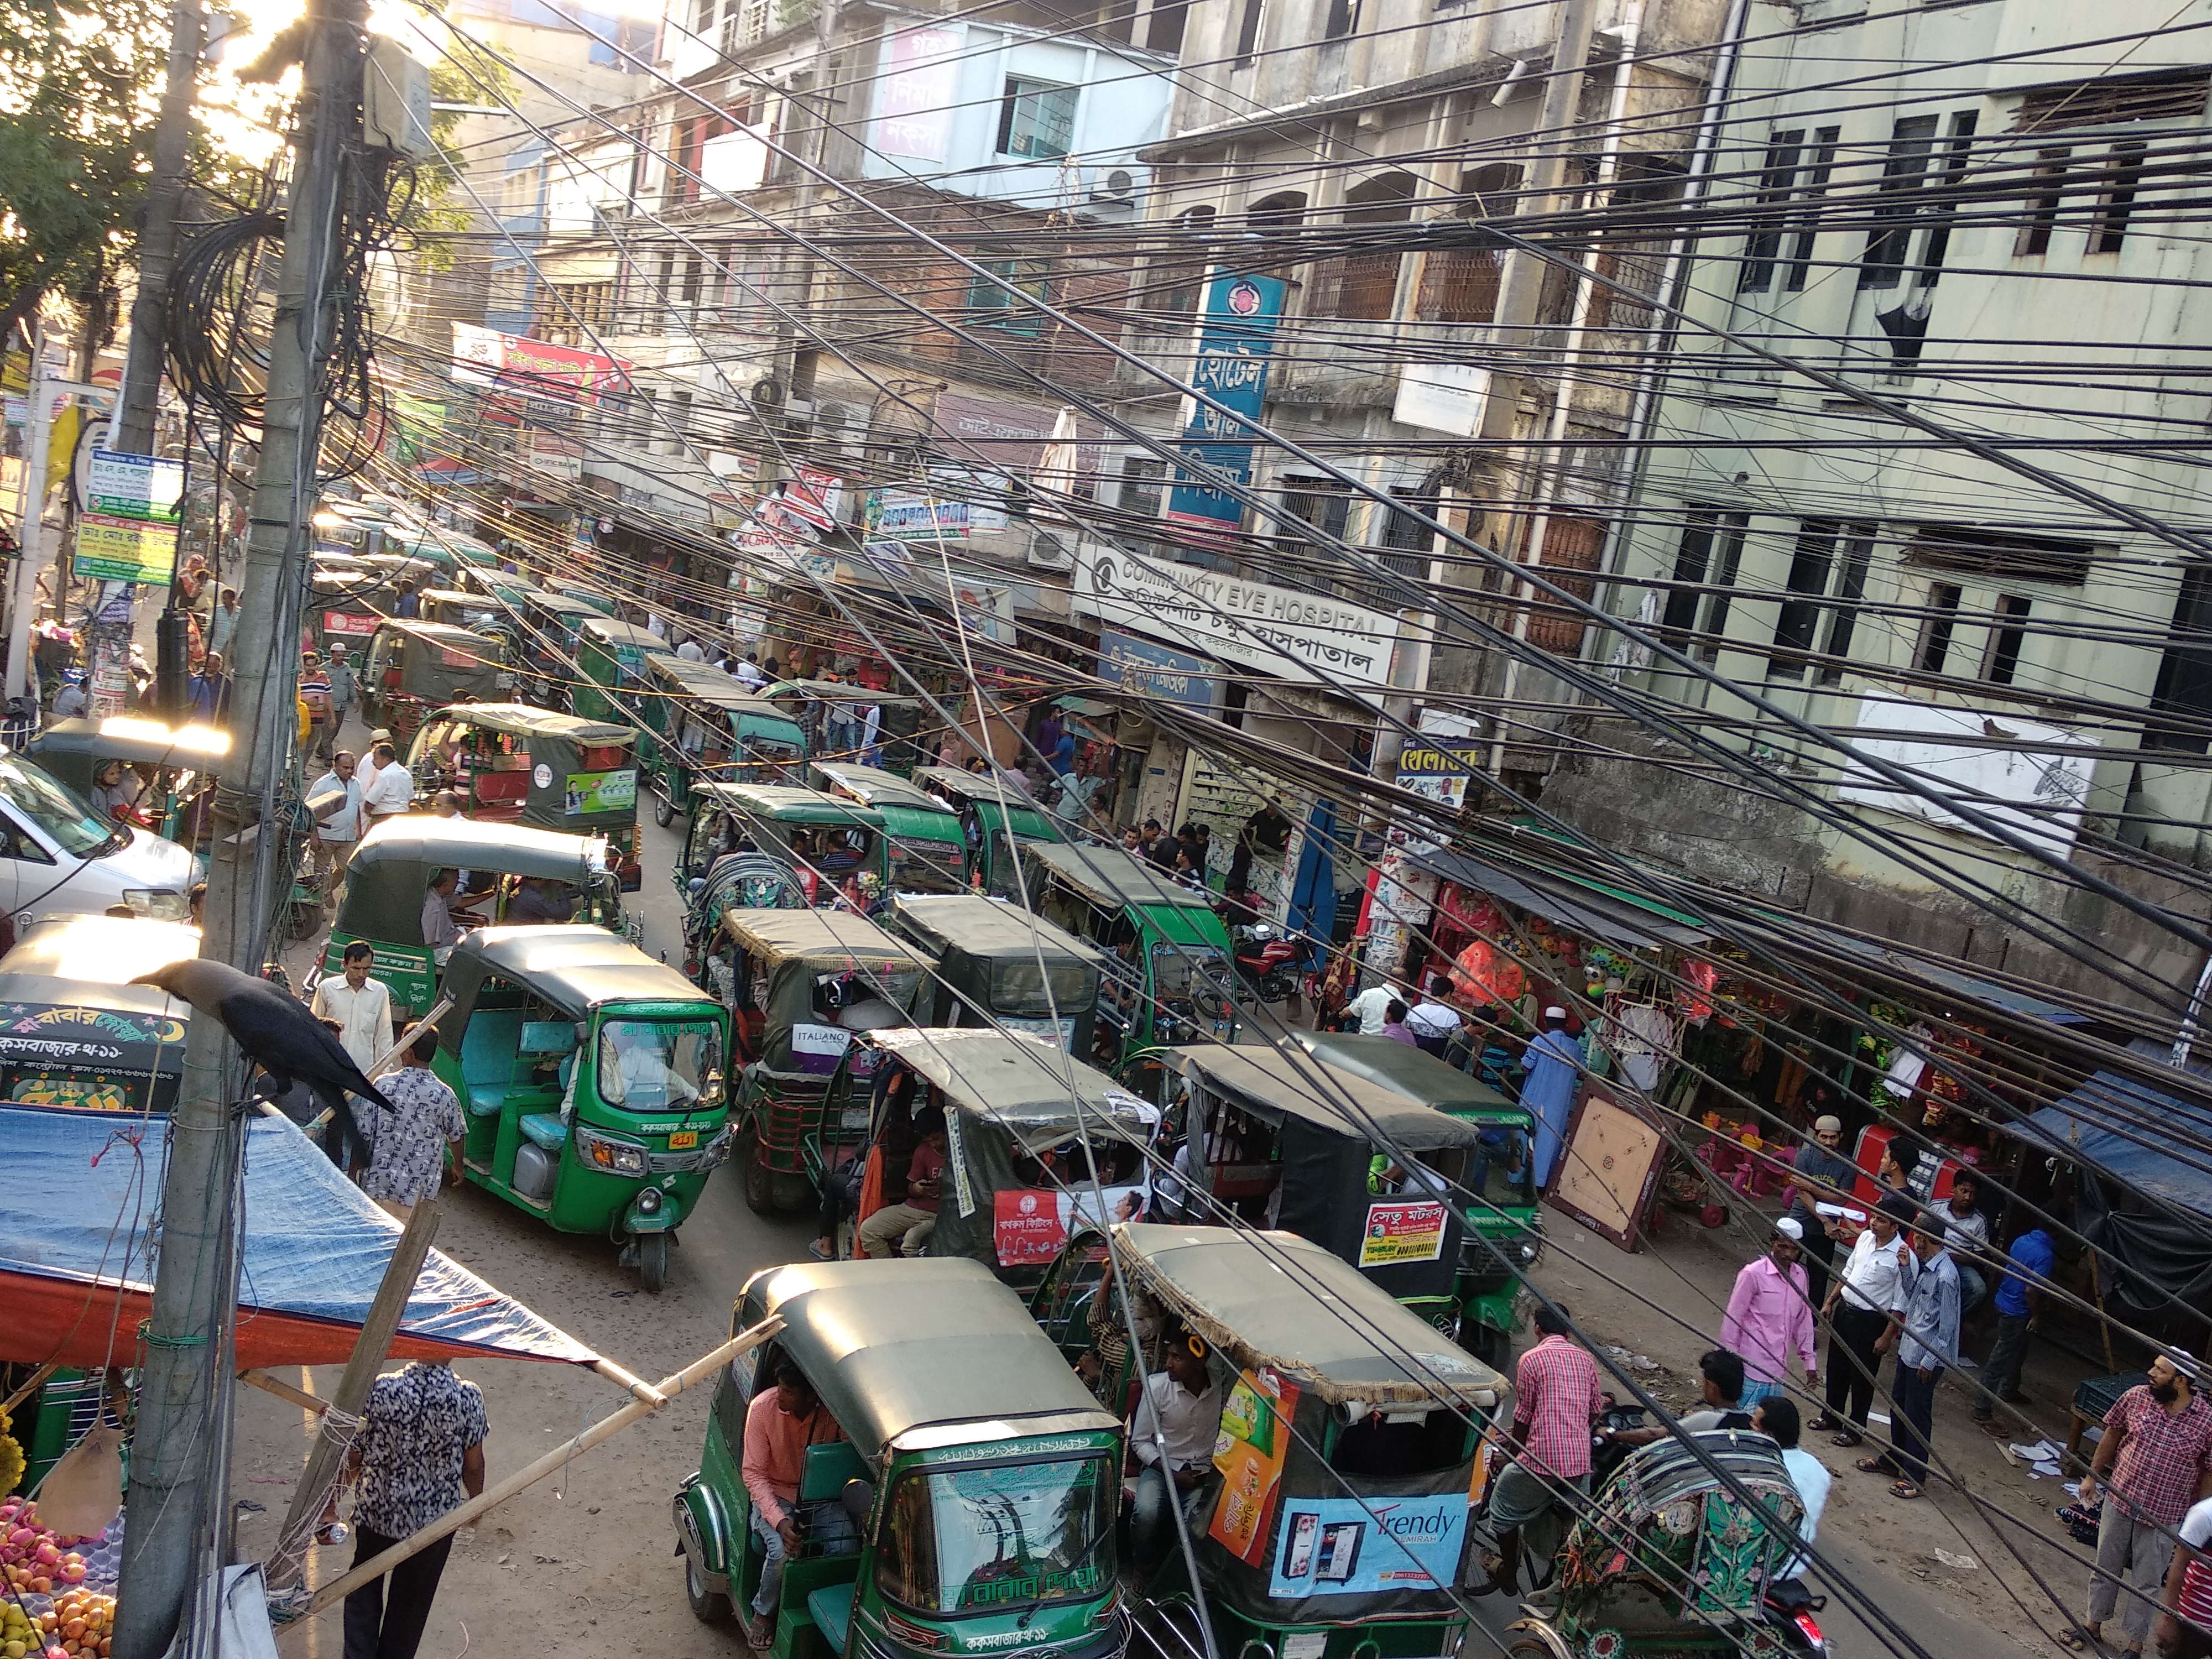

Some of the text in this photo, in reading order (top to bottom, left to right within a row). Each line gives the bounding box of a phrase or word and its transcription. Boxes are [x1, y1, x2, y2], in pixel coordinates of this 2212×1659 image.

[1123, 561, 1381, 645] COMMUNITY EYE HOSPITAL
[1252, 623, 1376, 675] হাসপাতাল
[34, 1006, 102, 1025] বাবার
[641, 1024, 681, 1036] বাবার
[684, 1023, 713, 1035] দোয়া
[1371, 1211, 1404, 1226] সেতু
[1373, 1503, 1457, 1542] Trendy
[973, 1575, 1040, 1603] বাবার
